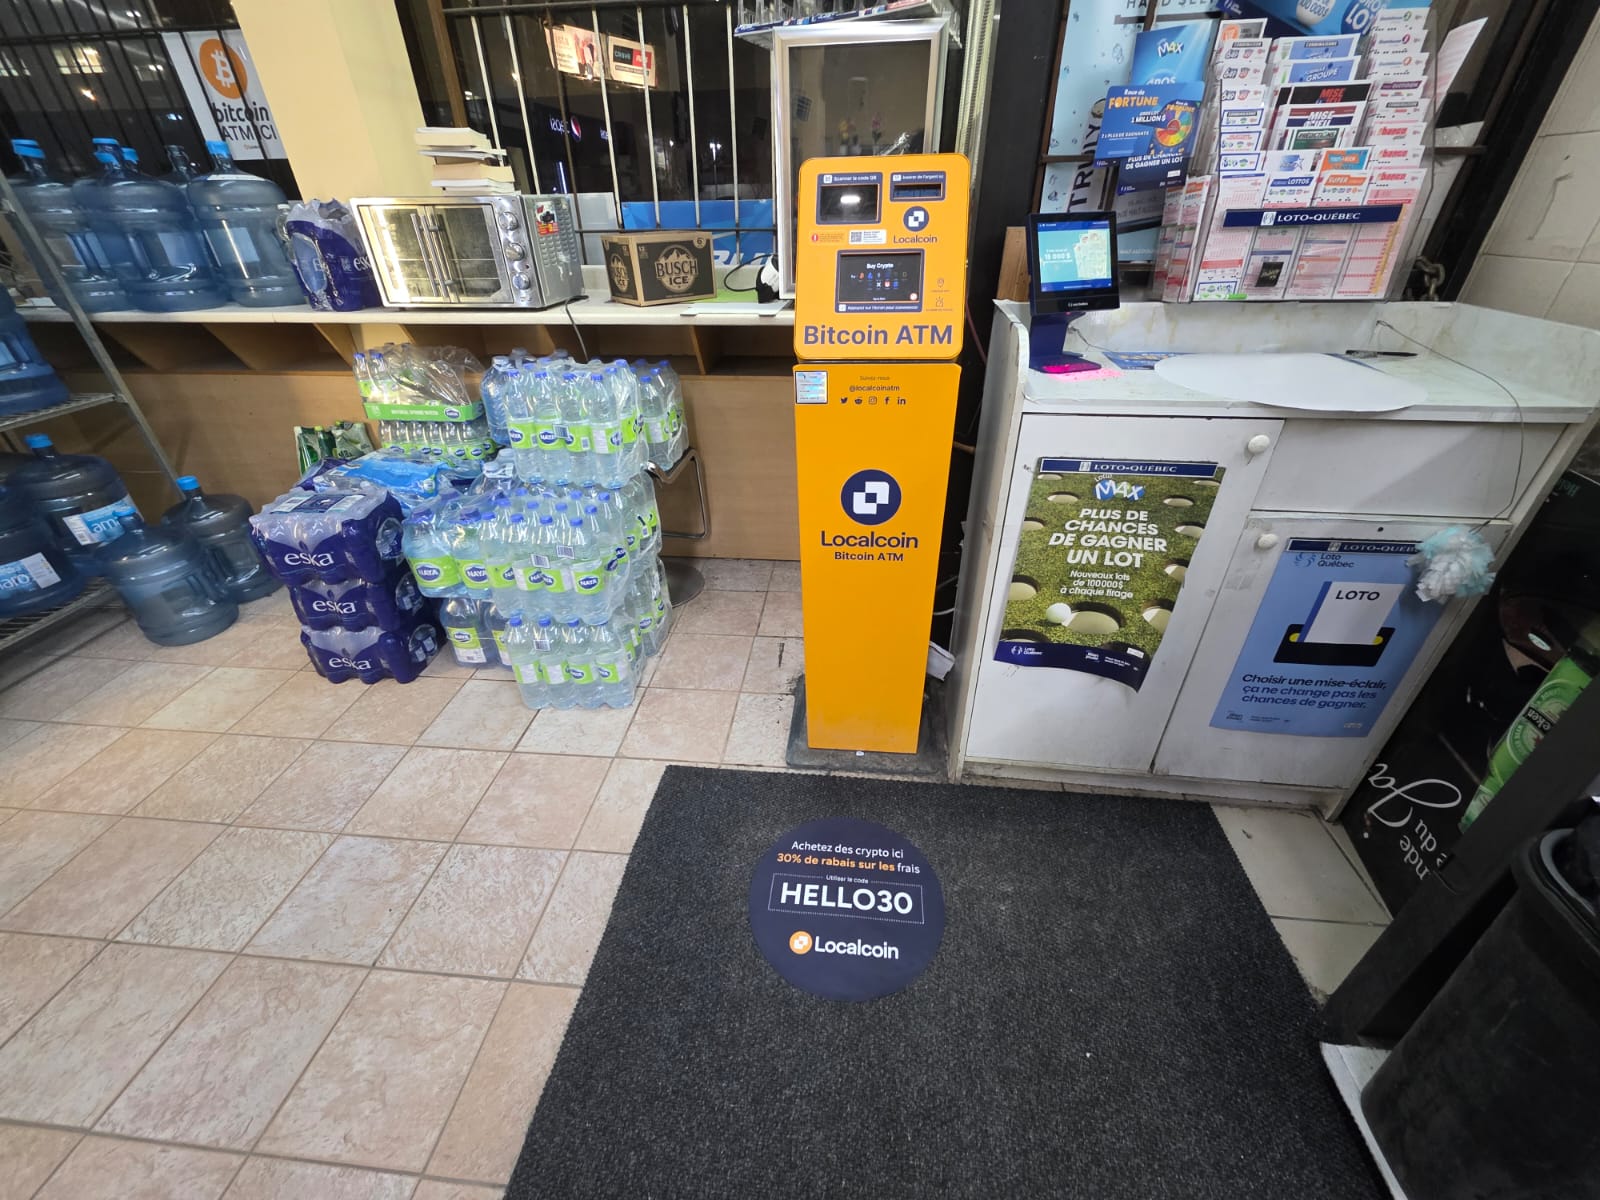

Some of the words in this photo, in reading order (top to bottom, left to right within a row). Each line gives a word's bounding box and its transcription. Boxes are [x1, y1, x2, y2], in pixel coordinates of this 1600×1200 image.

[1306, 68, 1338, 82] GROUPE
[1320, 88, 1345, 97] MISE
[1108, 96, 1158, 110] FORTUNE
[212, 102, 270, 122] bitcoin
[1308, 110, 1336, 120] MISE
[221, 125, 254, 140] ATM
[1277, 212, 1361, 222] LOTO-QUÉBEC
[893, 234, 937, 244] Localcoin
[656, 260, 698, 278] BUSCH
[669, 276, 688, 285] ICE
[804, 325, 888, 345] Bitcoin
[896, 325, 953, 345] ATM
[849, 384, 900, 392] @localcoinatm
[1094, 464, 1177, 473] LOTO-QUÉBEC
[1094, 480, 1144, 500] MAX
[1079, 508, 1121, 520] PLUS
[1126, 510, 1148, 521] DE
[1064, 520, 1158, 535] CHANCES
[821, 530, 918, 548] Localcoin
[1048, 533, 1076, 546] DE
[1080, 535, 1167, 553] GAGNER
[1343, 544, 1418, 553] LOTO-QUÉB
[284, 551, 333, 567] eska
[834, 552, 874, 561] Bitcoin
[878, 552, 904, 561] ATM
[1067, 550, 1099, 565] UN
[1103, 552, 1144, 568] LOT
[1317, 560, 1354, 568] Québec
[418, 568, 439, 576] NAYA
[1070, 570, 1114, 580] Nouveaux
[1115, 572, 1131, 581] lots
[579, 578, 597, 586] NAYA
[1060, 586, 1066, 594] à
[1068, 587, 1104, 598] chaque
[1106, 589, 1134, 599] tirage
[1336, 590, 1380, 601] LOTO
[312, 600, 356, 614] eska
[328, 657, 371, 670] eska
[1242, 674, 1288, 684] Choisir
[1288, 678, 1313, 686] une
[1314, 678, 1388, 690] mise-éclair,
[1242, 686, 1260, 695] ça
[1262, 687, 1279, 695] ne
[1280, 687, 1330, 699] change
[1331, 690, 1356, 700] pas
[1358, 690, 1377, 699] les
[1242, 694, 1297, 706] chances
[1299, 696, 1317, 706] de
[1317, 699, 1367, 709] gagner.
[1529, 709, 1553, 732] eken
[792, 841, 833, 852] Achetez
[835, 844, 853, 854] des
[855, 847, 889, 858] crypto
[892, 849, 904, 858] ici
[777, 853, 801, 864] 30%
[804, 855, 818, 865] de
[821, 857, 856, 868] rabais
[858, 860, 876, 870] sur
[879, 861, 895, 872] les
[897, 862, 920, 874] frais
[780, 882, 913, 914] HELLO30
[815, 936, 899, 959] Localcoin
